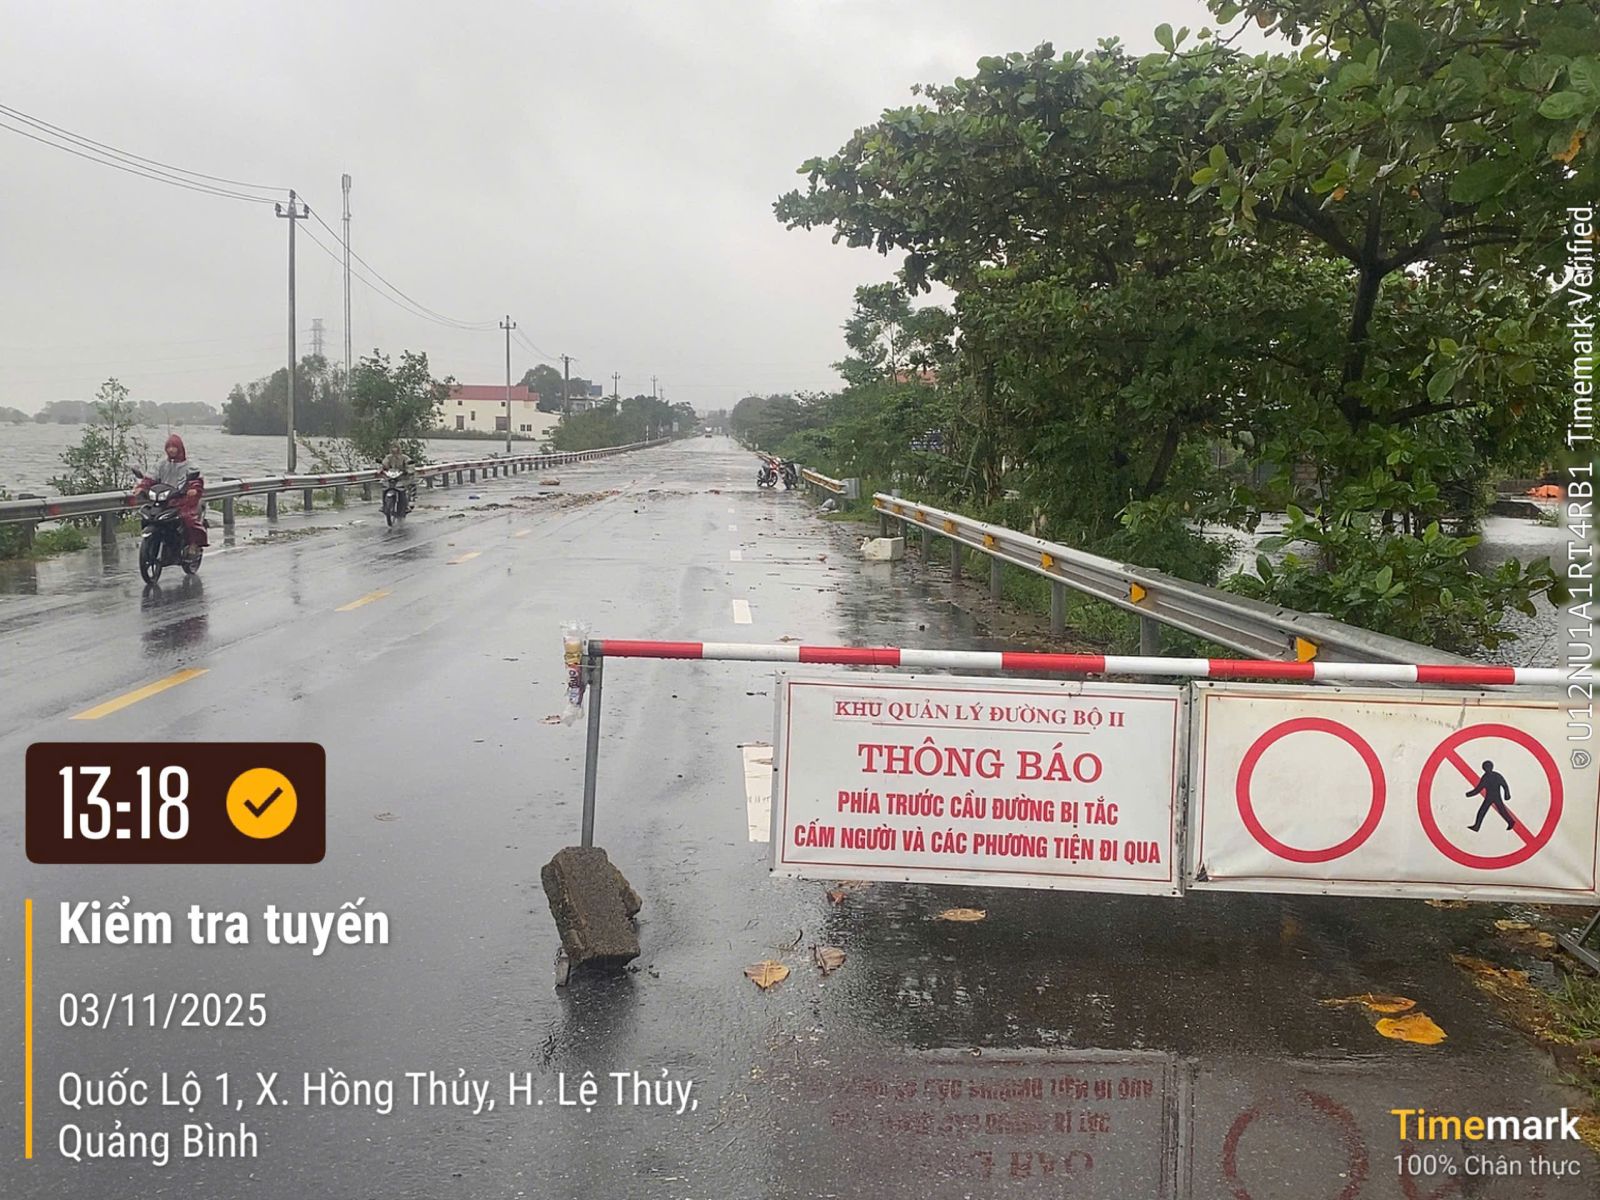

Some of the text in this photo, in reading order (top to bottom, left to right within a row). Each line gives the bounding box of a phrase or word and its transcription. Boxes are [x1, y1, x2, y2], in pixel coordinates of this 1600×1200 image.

[835, 699, 1126, 731] KHU QUẢN LÝ ĐƯỜNG BỘ II
[857, 736, 1104, 785] THÔNG BÁO
[837, 787, 1119, 829] PHÍA TRƯỚC CẦU ĐƯỜNG BỊ TẮC
[793, 818, 1162, 866] CẤM NGƯỜI VÀ CÁC PHƯƠNG TIỆN ĐI QUA
